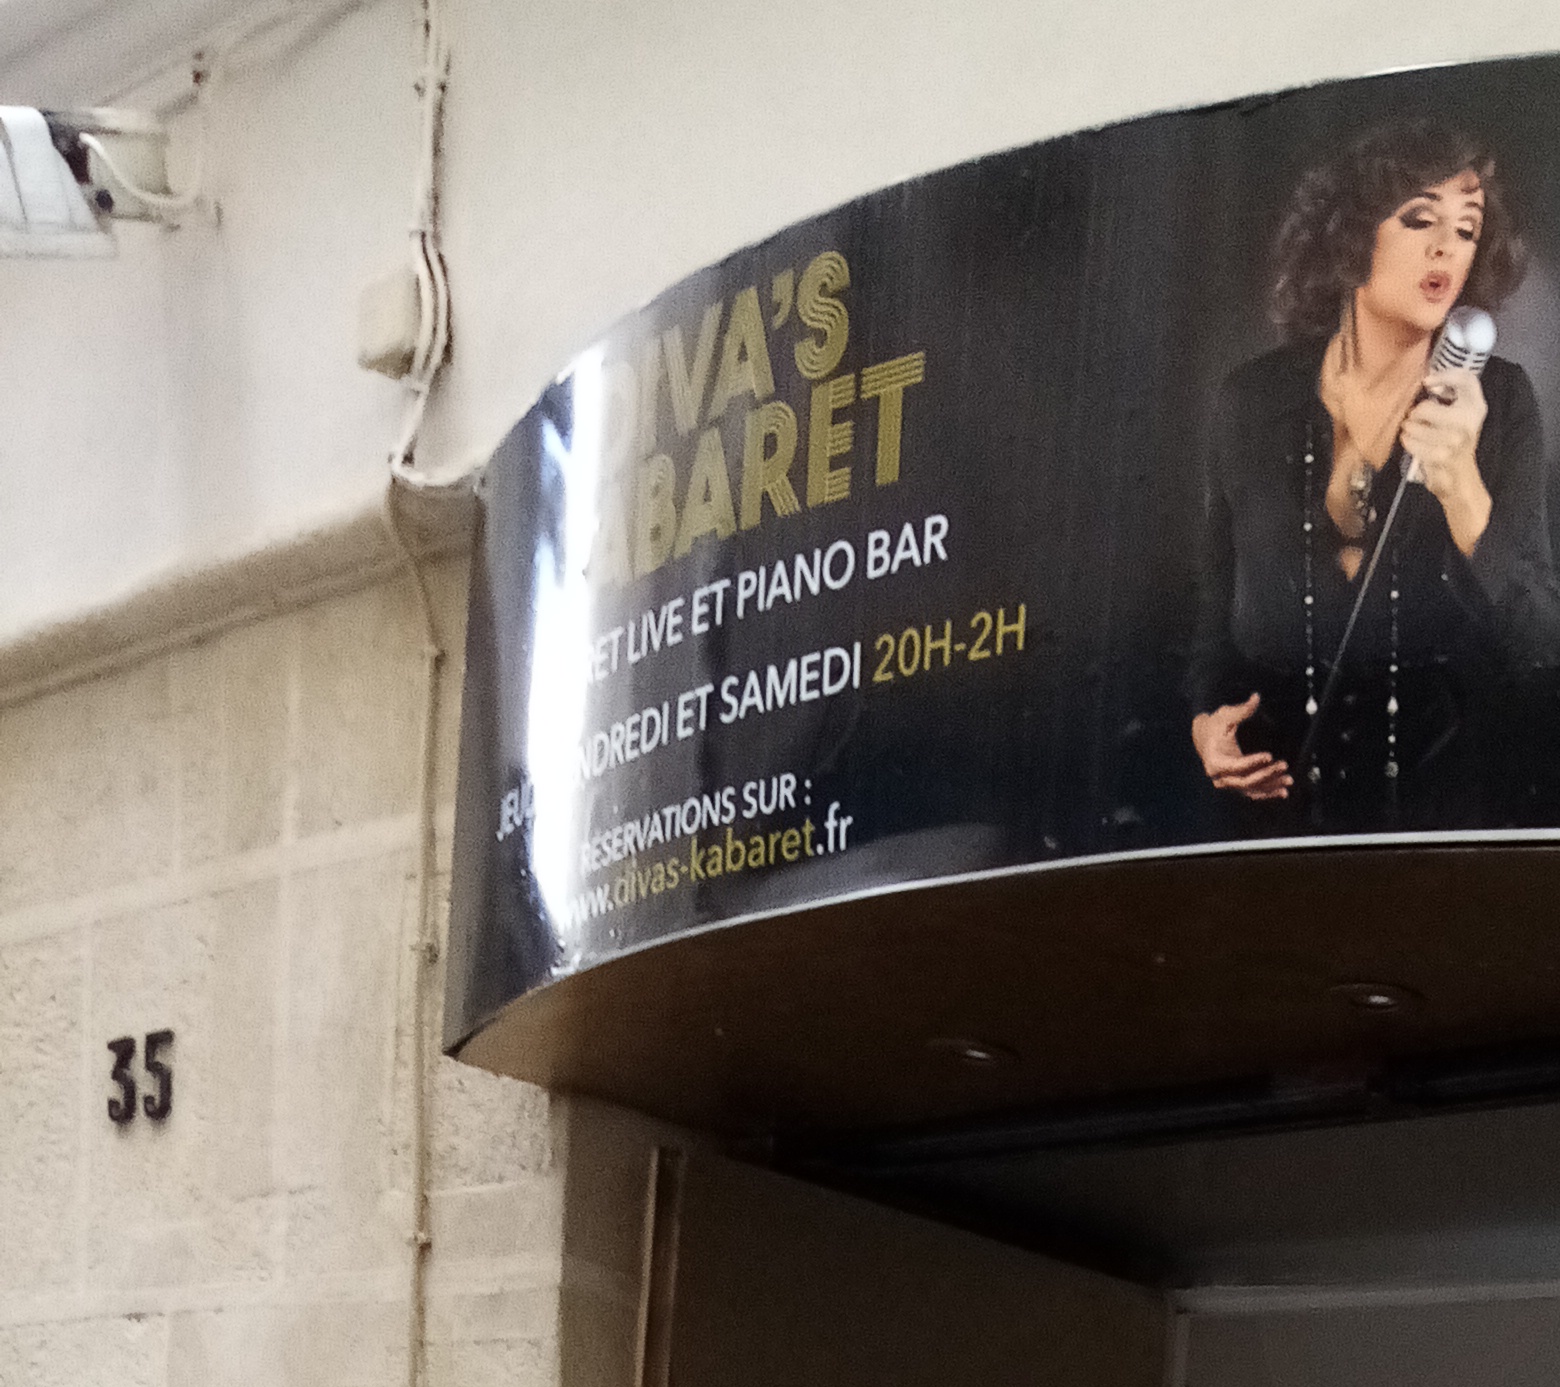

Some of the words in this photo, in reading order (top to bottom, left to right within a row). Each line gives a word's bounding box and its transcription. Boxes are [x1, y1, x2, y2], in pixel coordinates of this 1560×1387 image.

[626, 597, 686, 666] LIVE
[691, 578, 732, 636] ET
[735, 540, 856, 621] PIANO
[866, 513, 949, 580] BAR
[576, 701, 669, 782] NDREDI
[676, 683, 715, 741] ET
[719, 641, 862, 725] SAMEDI
[872, 603, 1028, 684] 20H-2H
[742, 773, 797, 819] SUR
[107, 1029, 175, 1124] 35
